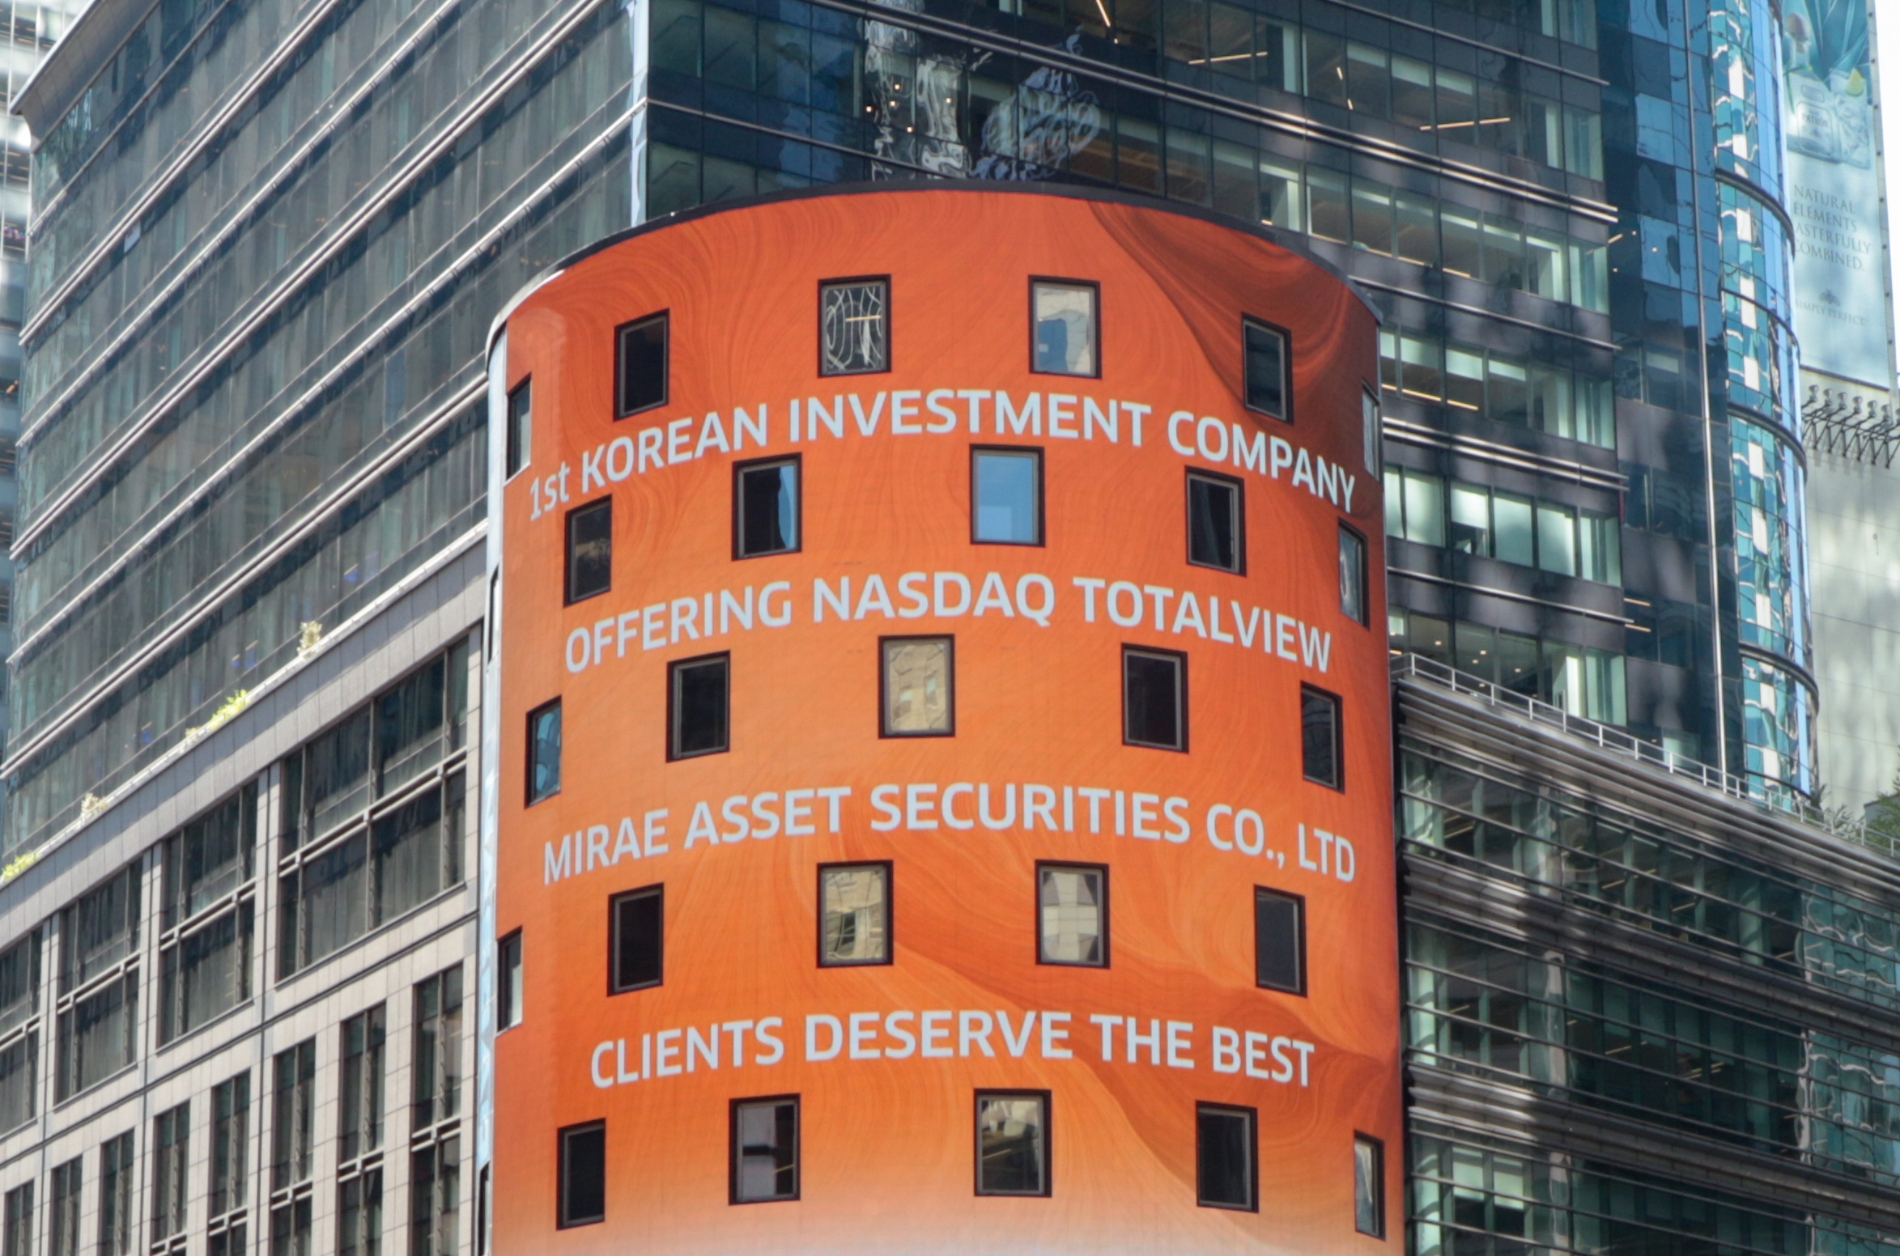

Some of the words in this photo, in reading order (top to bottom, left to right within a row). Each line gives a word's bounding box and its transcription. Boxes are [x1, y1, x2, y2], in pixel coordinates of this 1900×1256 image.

[1793, 184, 1855, 214] NATURAL
[1793, 203, 1858, 232] ELEMENTS
[1795, 222, 1872, 254] ASTERFULLY
[1828, 307, 1867, 326] PERFECT
[530, 465, 570, 521] 1st
[581, 402, 768, 488] KOREAN
[790, 388, 1151, 446] INVESTMENT
[1168, 409, 1355, 514] COMPANY
[565, 580, 792, 673] OFFERING
[813, 571, 1055, 627] NASDAQ
[1073, 576, 1332, 673] TOTALVIEW
[543, 808, 668, 885] MIRAE
[684, 787, 851, 851] ASSET
[869, 782, 1191, 844] SECURITIES
[1207, 803, 1286, 865] CO.,
[1298, 823, 1356, 884] LTD
[590, 1017, 785, 1089] CLIENTS
[805, 1010, 1074, 1062] DESERVE
[1090, 1013, 1196, 1070] THE
[1212, 1025, 1316, 1088] BEST
